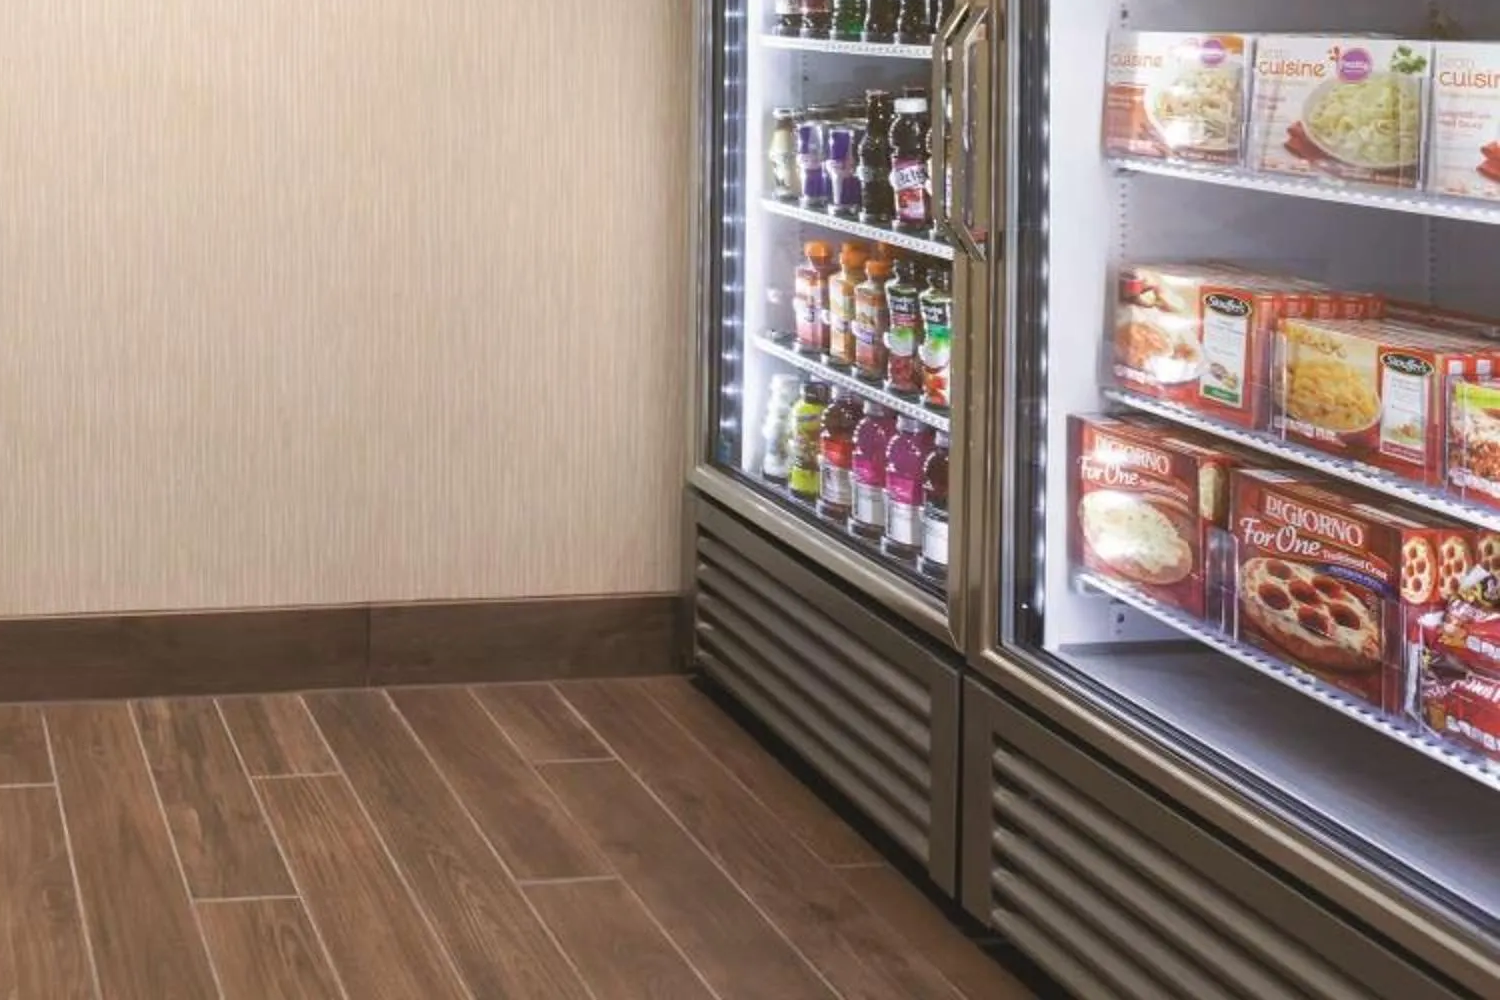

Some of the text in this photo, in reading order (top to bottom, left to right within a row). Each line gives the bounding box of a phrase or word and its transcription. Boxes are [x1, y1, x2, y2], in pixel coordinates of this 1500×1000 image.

[1258, 60, 1327, 79] cuisine
[1104, 461, 1141, 486] One
[1239, 516, 1276, 547] For
[1276, 525, 1322, 556] One
